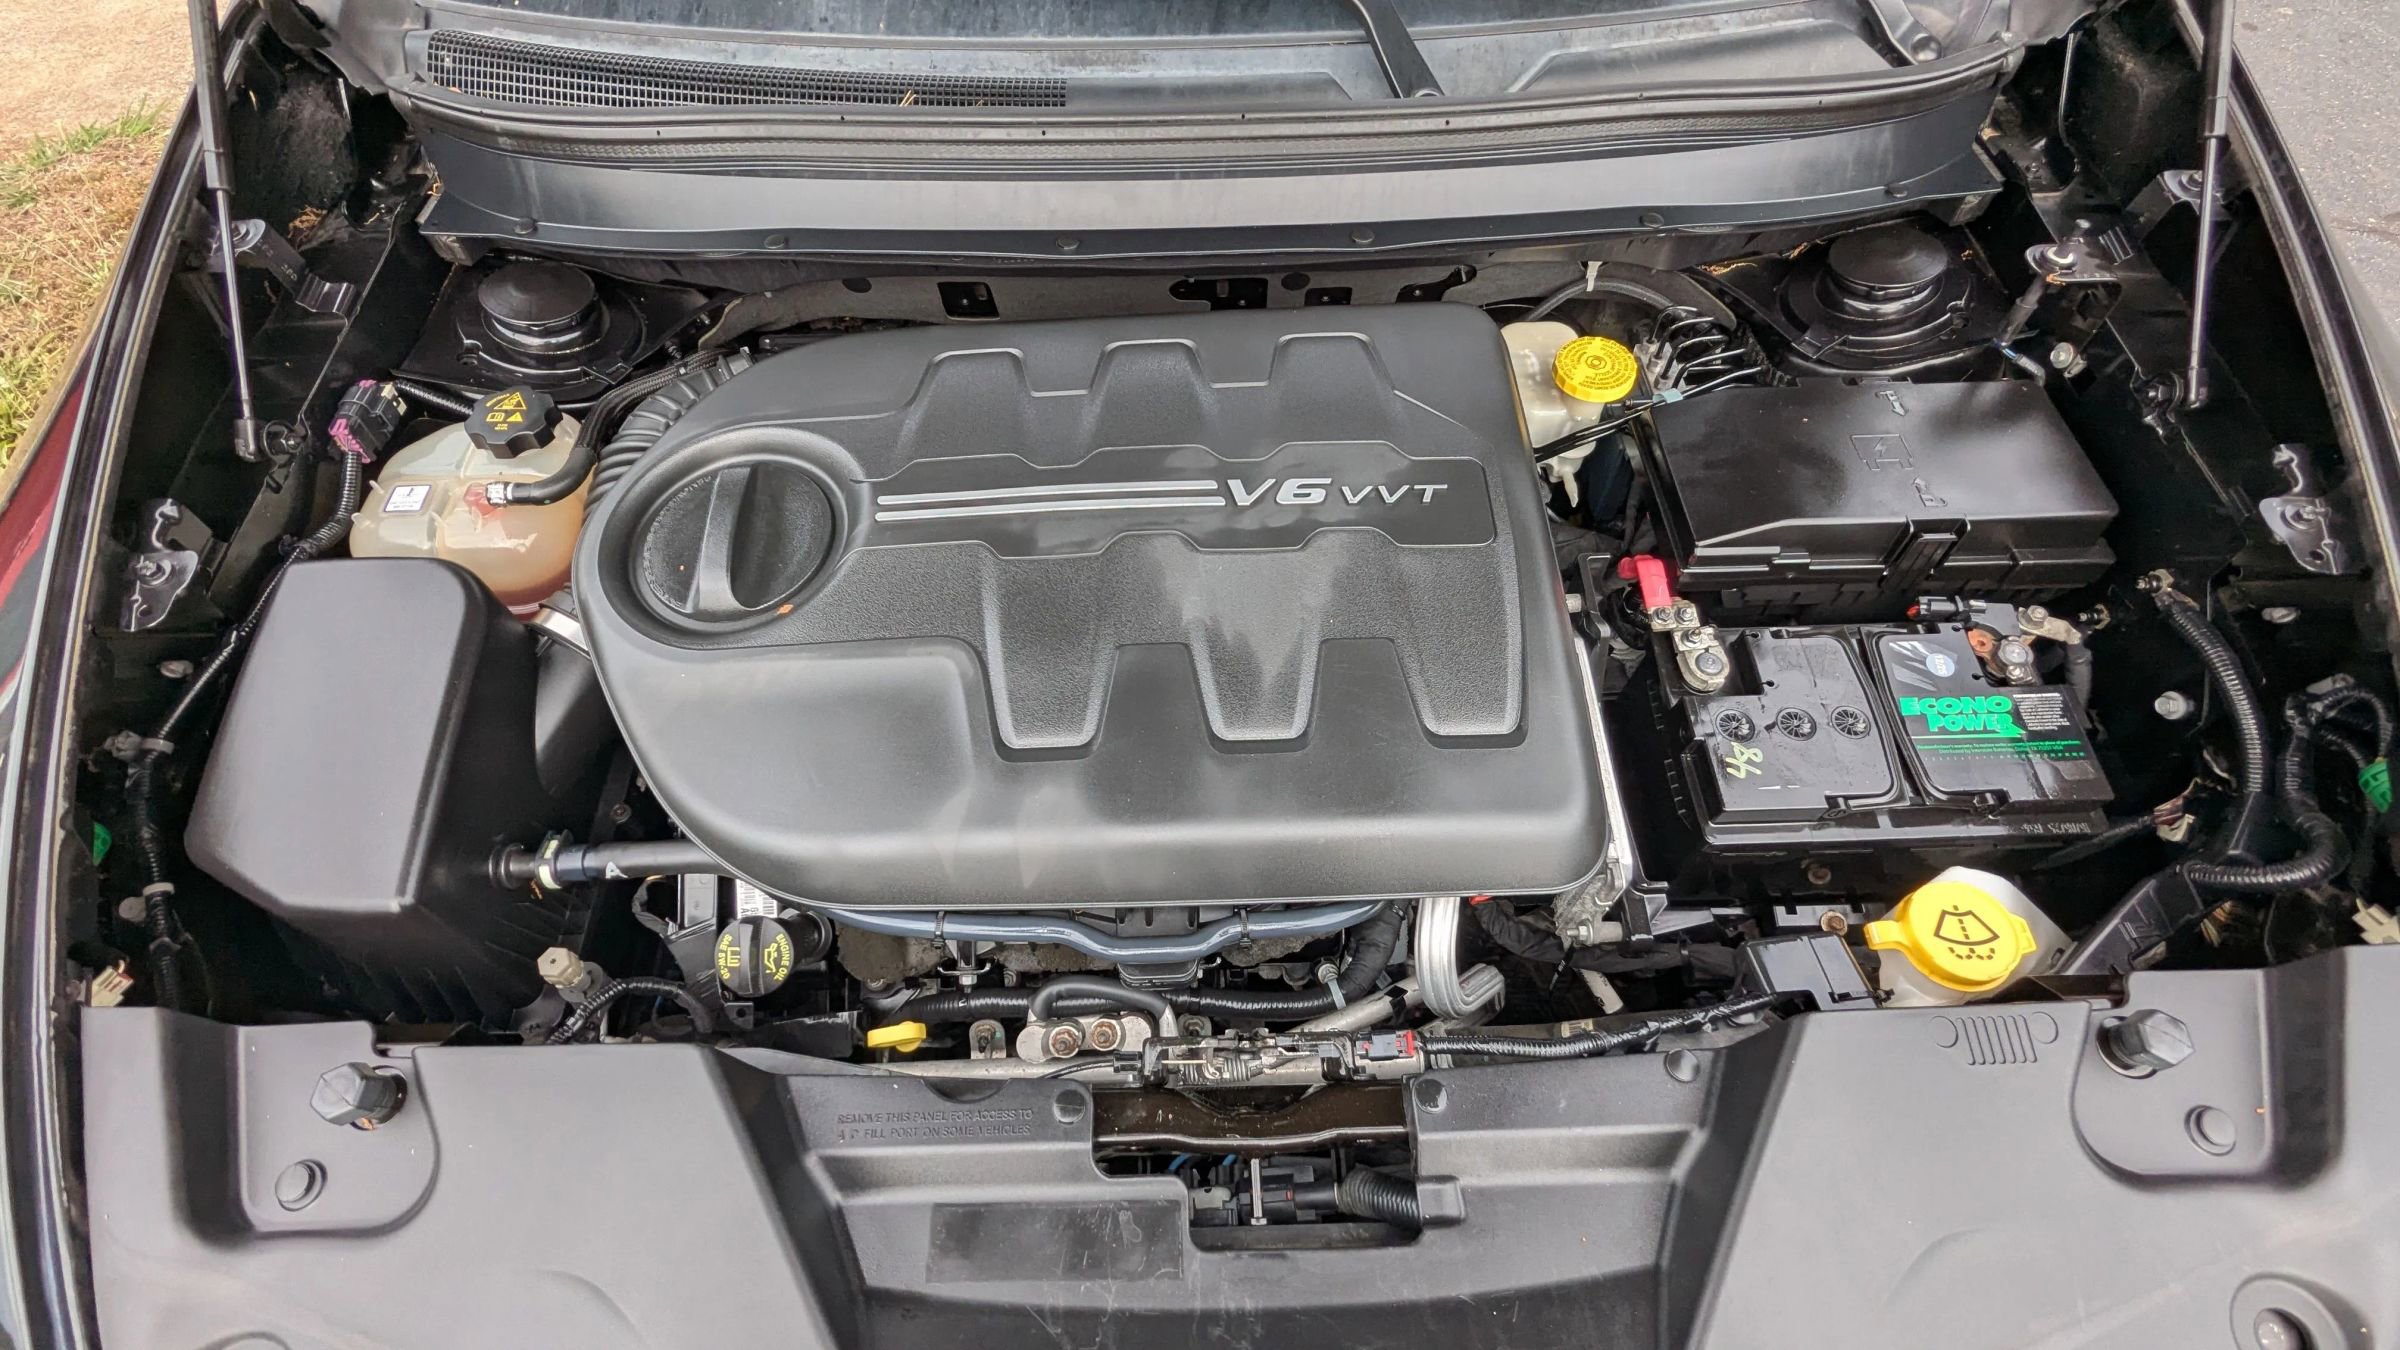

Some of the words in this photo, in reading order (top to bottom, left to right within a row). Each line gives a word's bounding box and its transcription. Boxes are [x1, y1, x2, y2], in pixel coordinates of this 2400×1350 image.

[1227, 477, 1332, 506] V6
[1341, 483, 1448, 505] VVT
[1899, 695, 2013, 716] ECONO
[1926, 712, 2018, 733] POWER
[1725, 741, 1763, 778] 48
[719, 934, 733, 950] SAE
[775, 933, 790, 966] ENGINE
[718, 952, 731, 979] 5W-20
[773, 966, 788, 981] OIL
[837, 1112, 883, 1124] REMOVE
[885, 1111, 910, 1123] THIS
[912, 1110, 948, 1123] PANEL
[950, 1110, 972, 1122] FOR
[974, 1108, 1017, 1121] ACCESS
[1018, 1107, 1034, 1120] TO
[864, 1127, 886, 1139] FILL
[891, 1126, 919, 1138] PORT
[922, 1126, 940, 1138] ON
[942, 1125, 974, 1138] SOME
[977, 1123, 1032, 1137] VEHICLES
